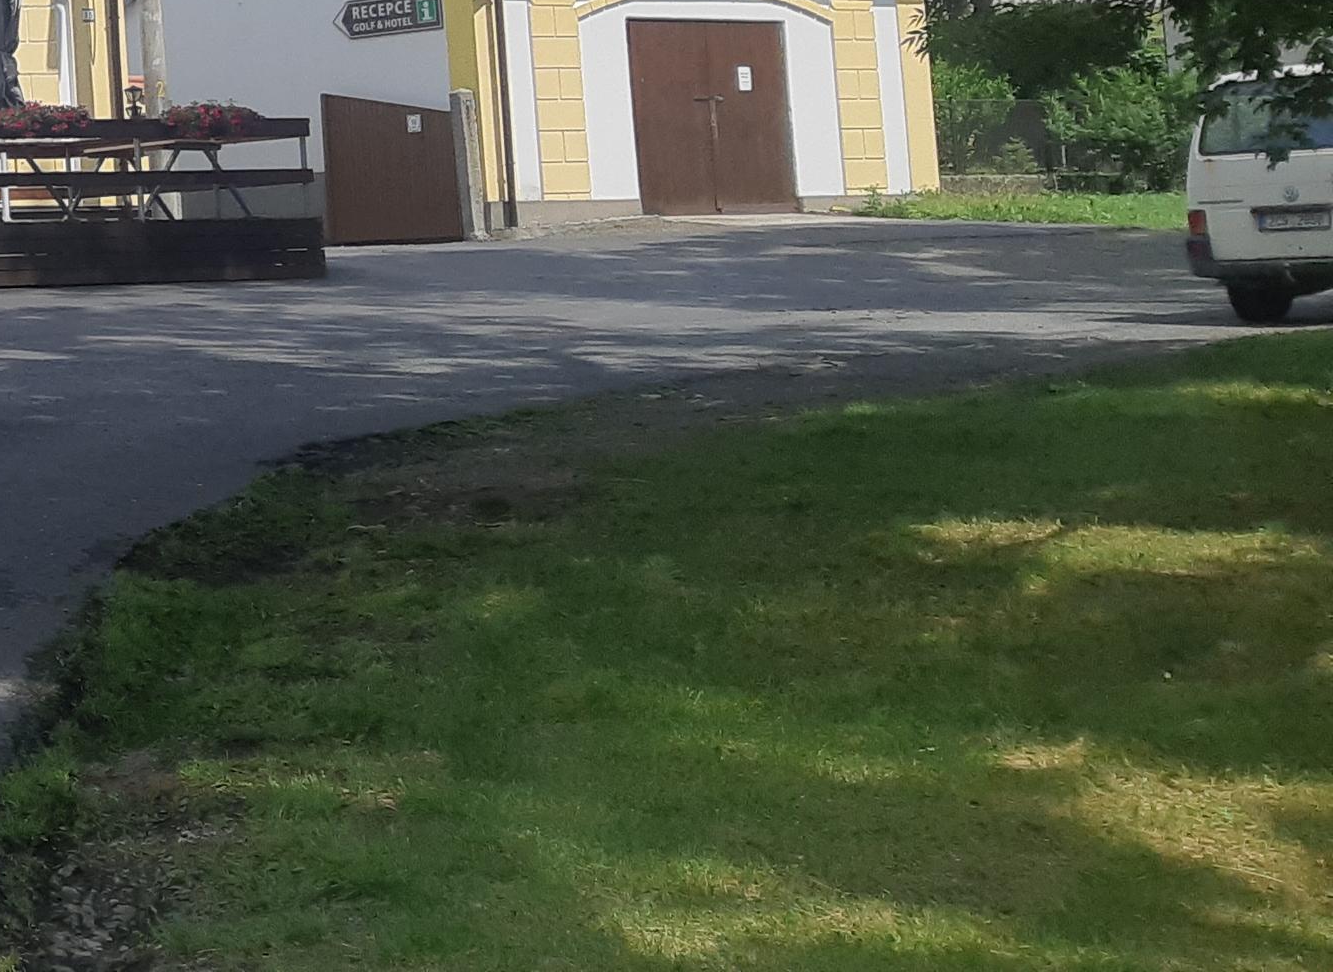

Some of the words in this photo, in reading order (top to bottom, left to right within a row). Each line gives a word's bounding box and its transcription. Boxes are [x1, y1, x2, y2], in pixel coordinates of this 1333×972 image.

[352, 0, 412, 20] RECEPCE
[353, 22, 376, 32] GOLF
[377, 20, 384, 30] &
[384, 17, 413, 28] HOTEL
